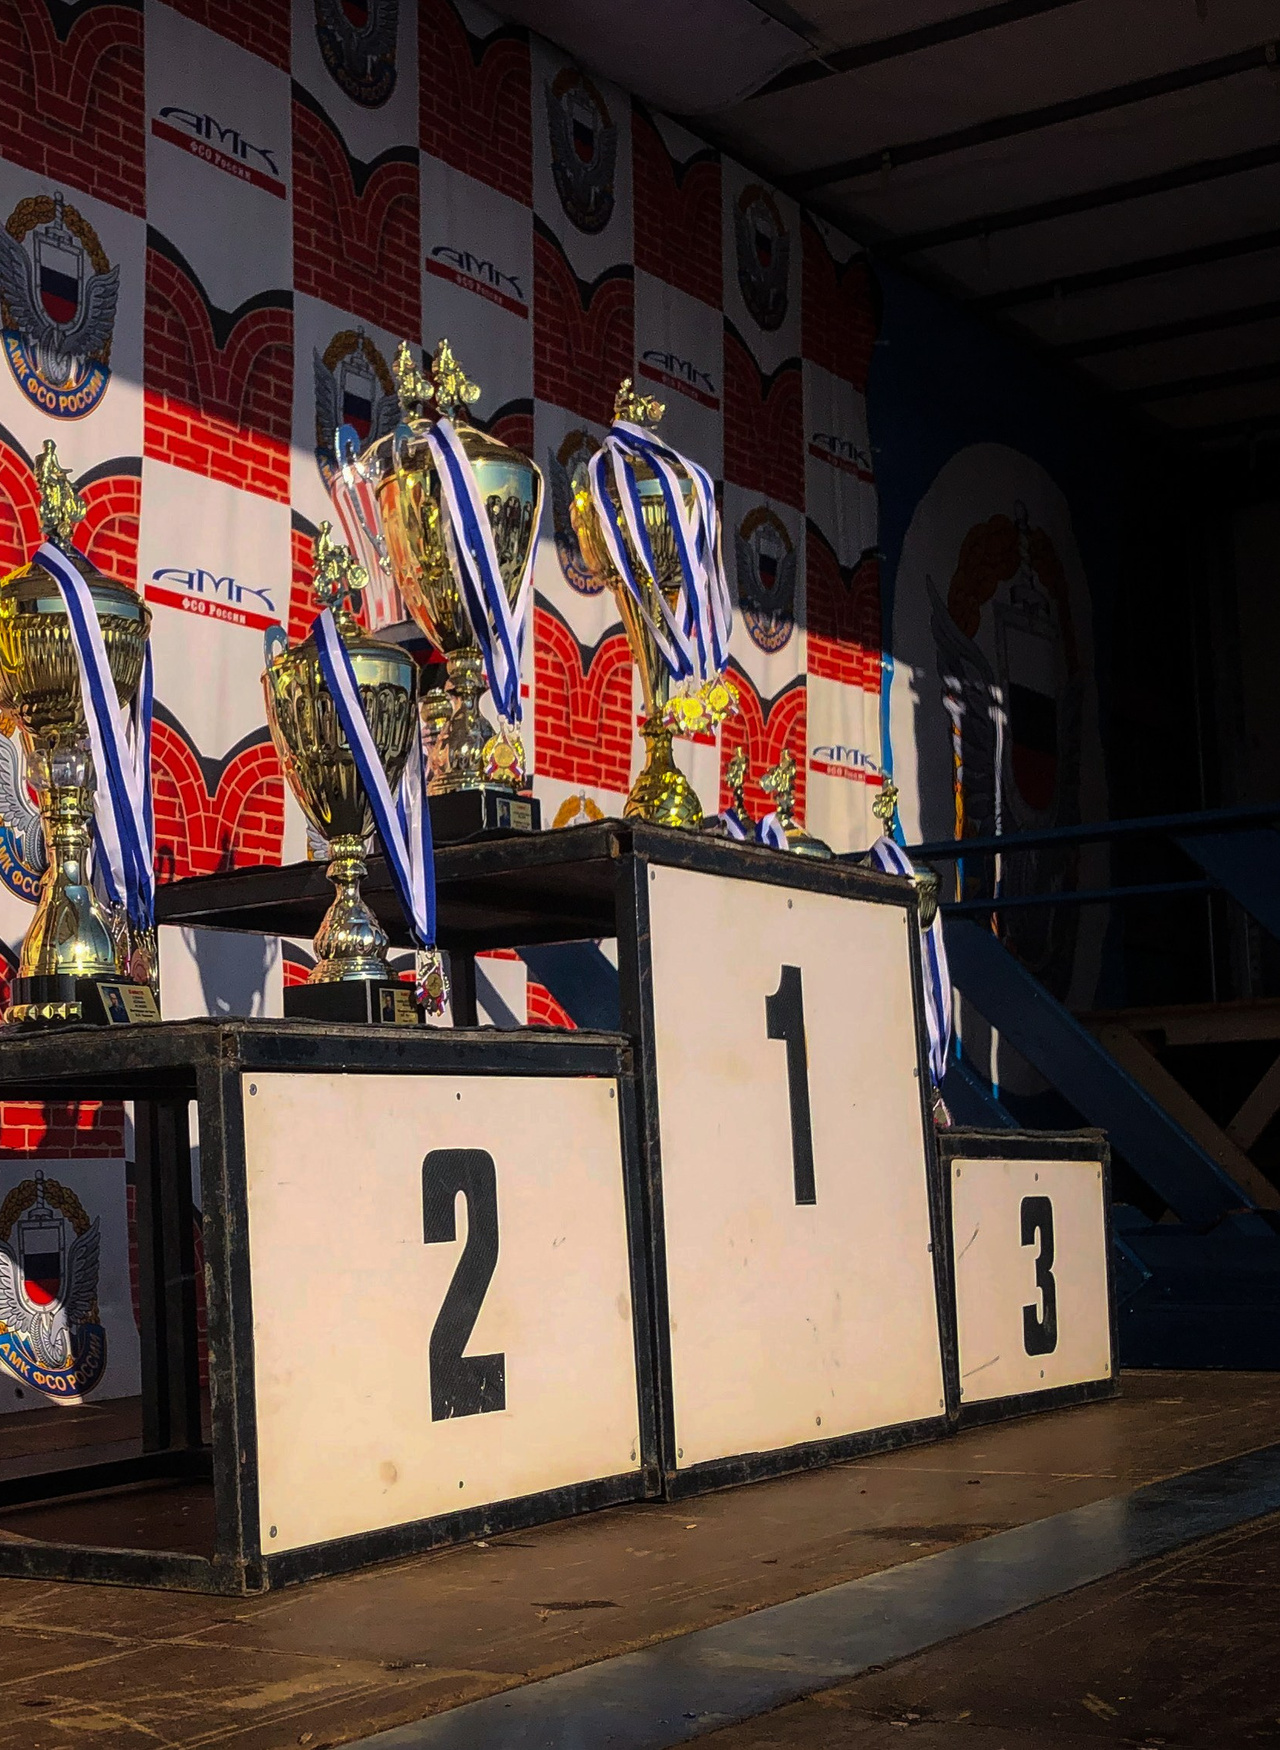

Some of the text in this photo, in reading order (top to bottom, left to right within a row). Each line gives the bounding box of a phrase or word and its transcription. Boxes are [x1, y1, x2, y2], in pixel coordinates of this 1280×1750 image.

[159, 107, 279, 176] АМК
[190, 141, 211, 160] ФСО
[432, 247, 524, 299] АМК
[8, 337, 105, 413] АМК ФСО РОССИИ
[643, 351, 715, 394] АМК
[813, 433, 870, 469] АМК
[152, 568, 275, 612] АМК
[182, 597, 247, 625] ФСО России
[813, 745, 877, 771] АМК
[11, 871, 42, 896] ФСО
[764, 964, 816, 1206] 1
[421, 1148, 505, 1422] 2
[1021, 1196, 1057, 1357] 3
[0, 1333, 101, 1391] АМК ФСО РОССИИ
